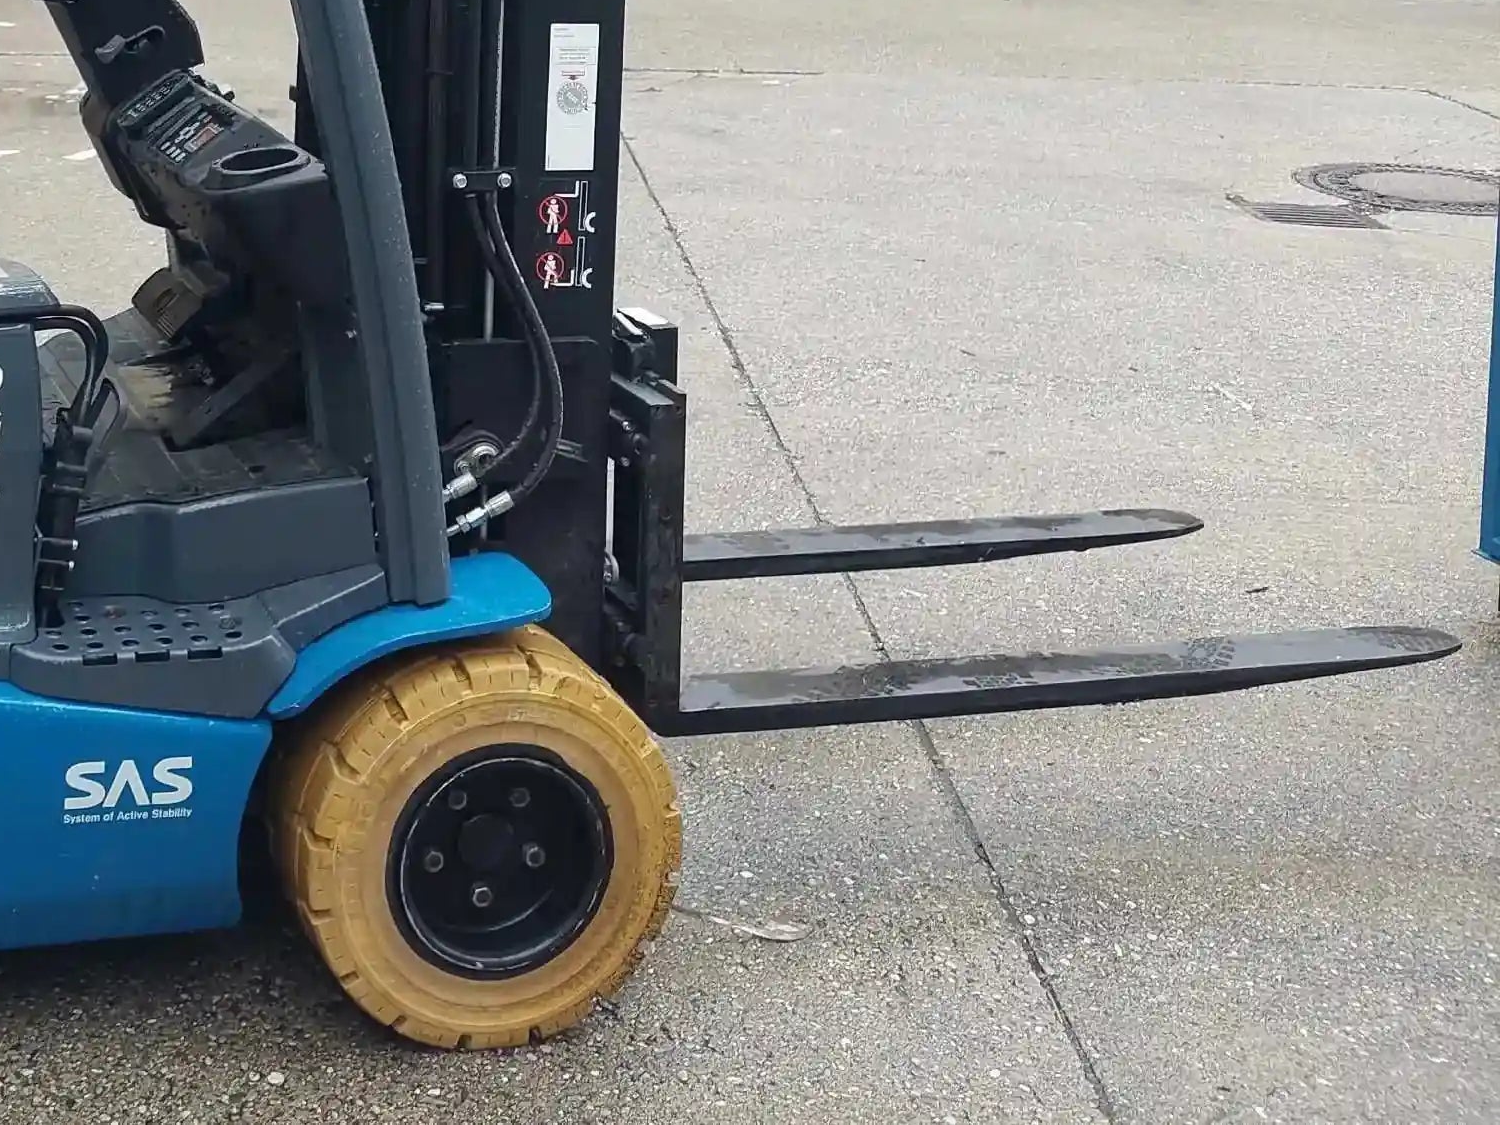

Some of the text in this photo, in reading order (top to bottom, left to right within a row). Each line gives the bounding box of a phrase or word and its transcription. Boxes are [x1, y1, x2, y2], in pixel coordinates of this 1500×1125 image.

[64, 756, 193, 810] SAS
[63, 807, 193, 824] System of Active Stability
